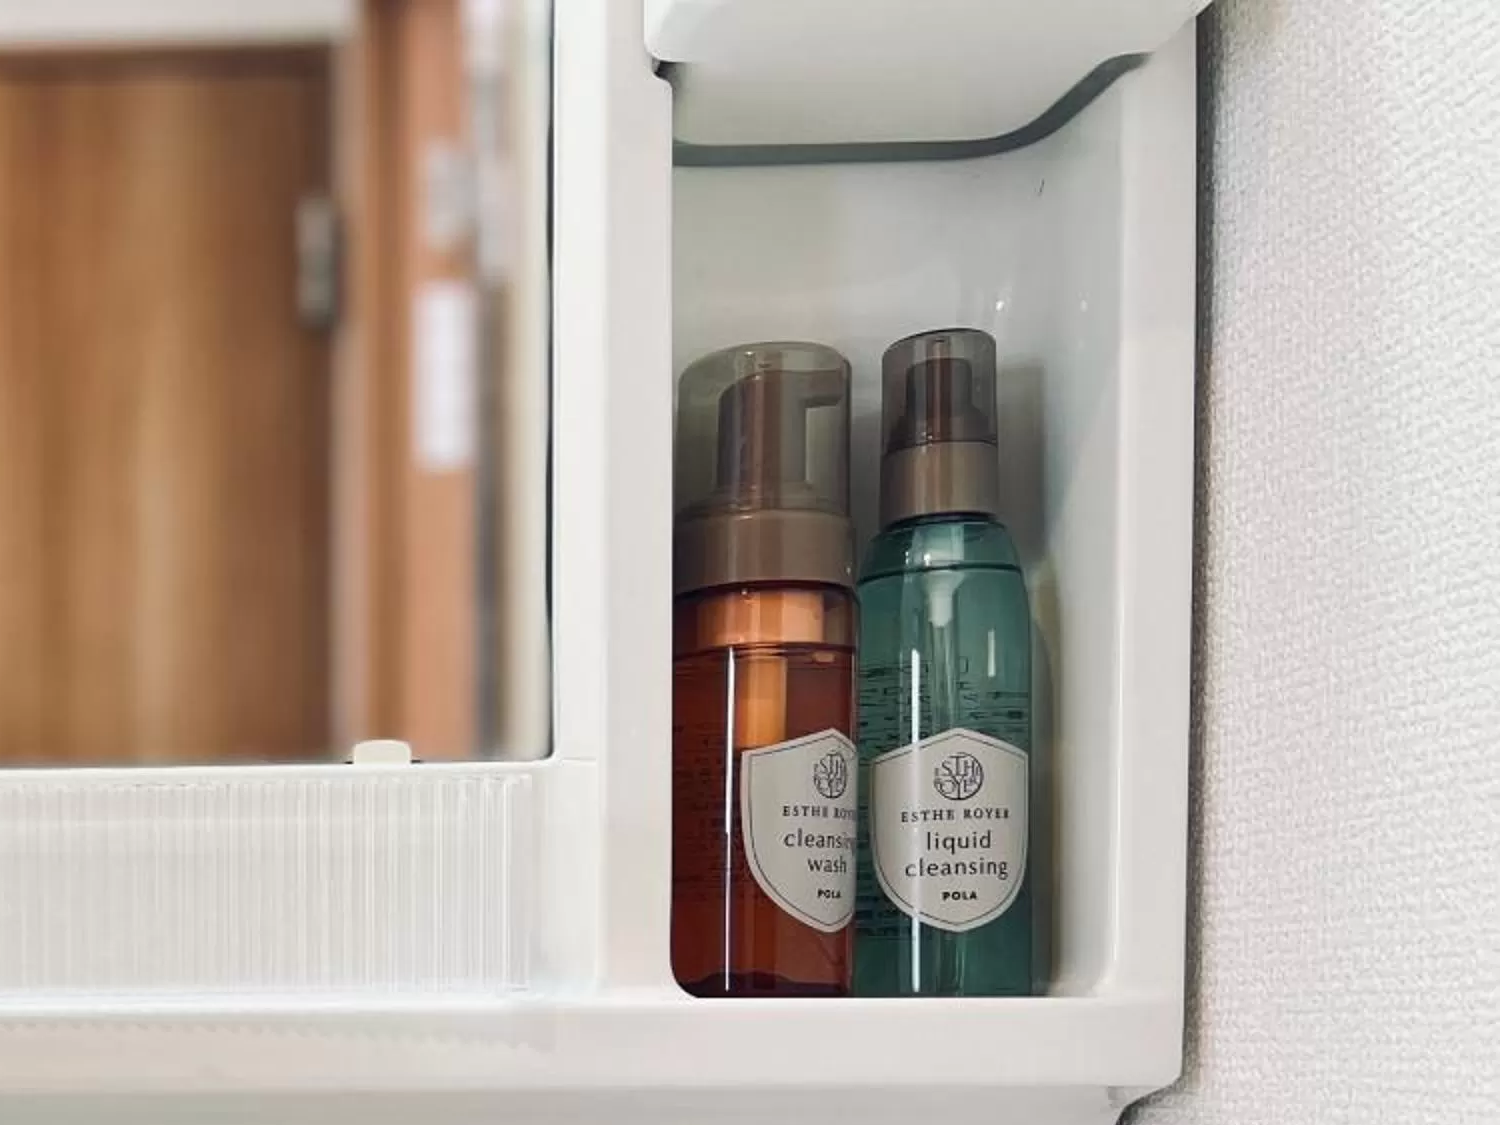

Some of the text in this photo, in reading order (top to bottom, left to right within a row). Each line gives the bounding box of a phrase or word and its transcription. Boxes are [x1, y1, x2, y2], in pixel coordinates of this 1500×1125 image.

[782, 805, 828, 818] ESTHE
[901, 807, 1009, 823] ESTHE ROYER
[927, 830, 991, 855] liquid
[807, 856, 848, 873] wash
[904, 857, 1009, 881] cleansing
[817, 888, 842, 899] POLA
[941, 891, 978, 901] POLA
